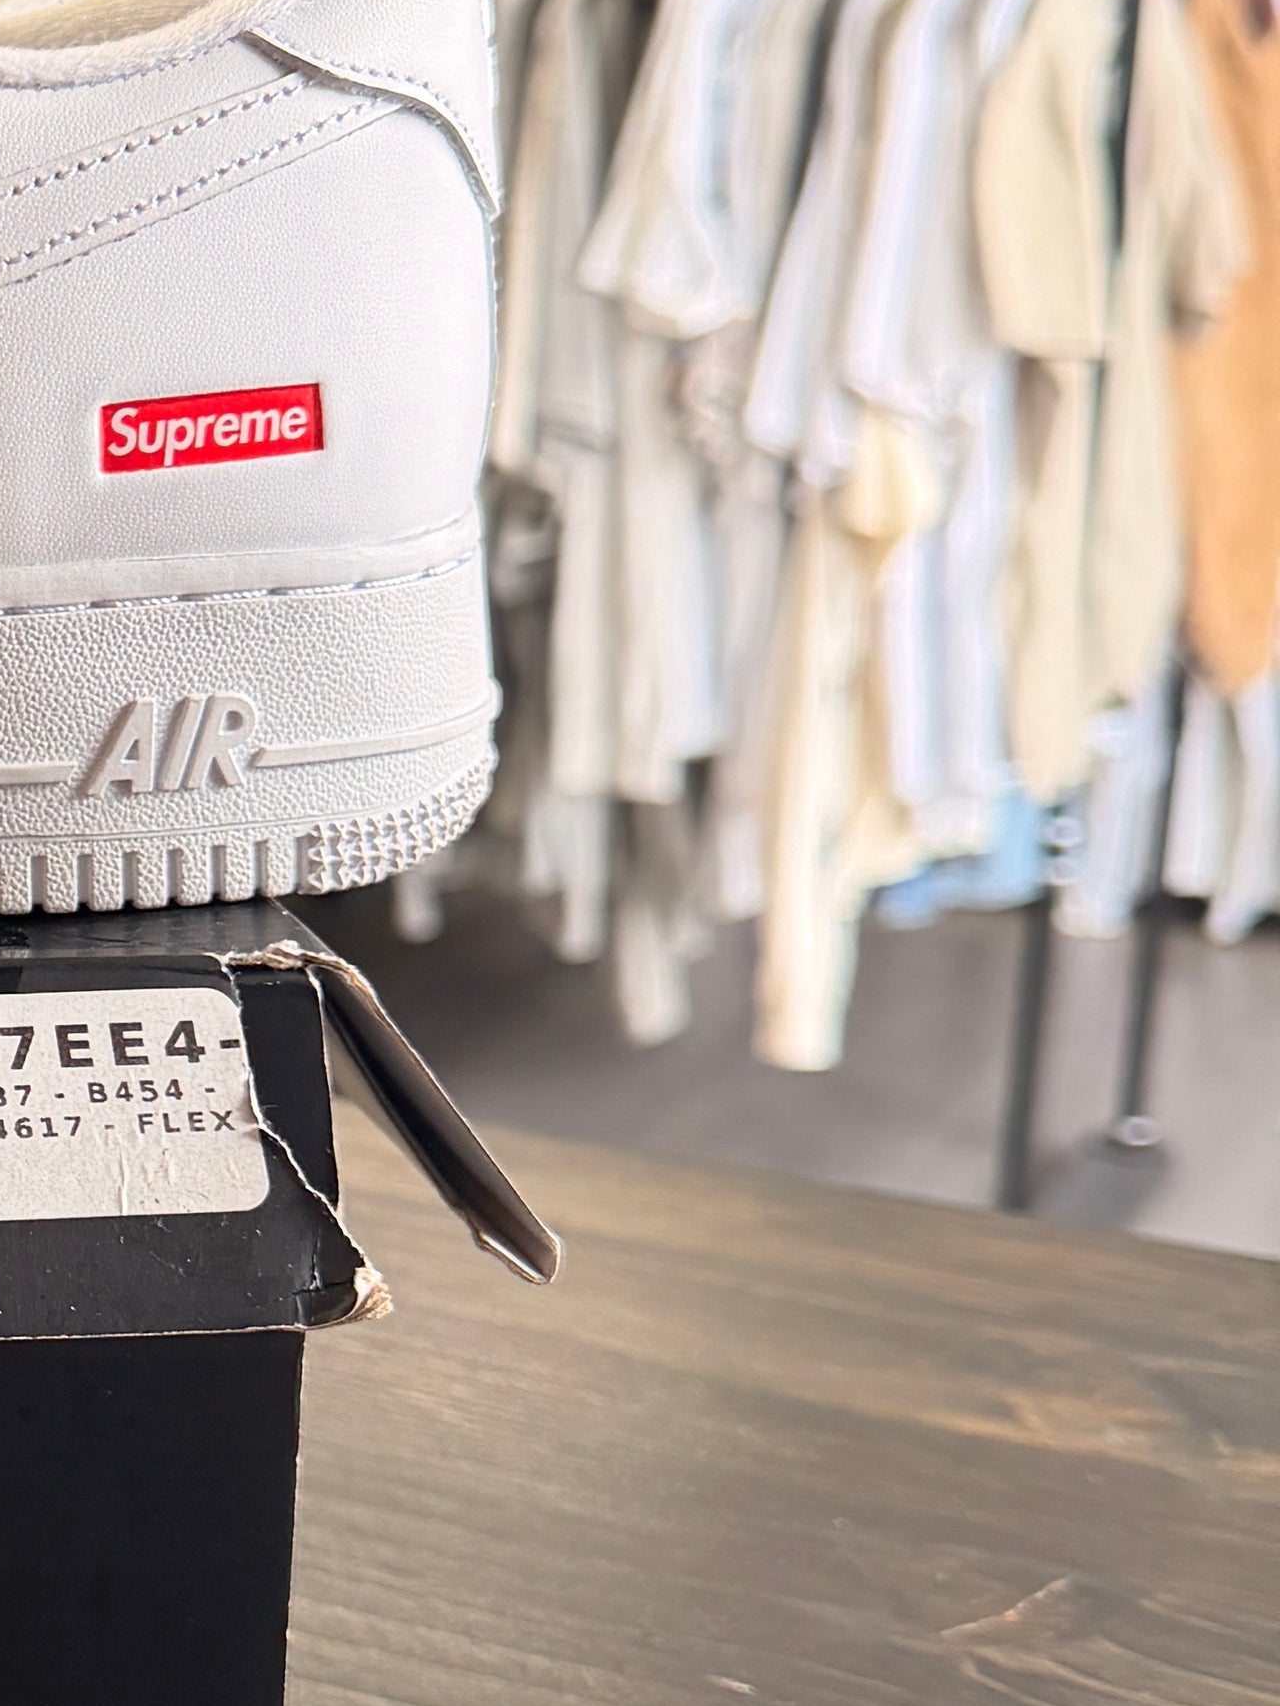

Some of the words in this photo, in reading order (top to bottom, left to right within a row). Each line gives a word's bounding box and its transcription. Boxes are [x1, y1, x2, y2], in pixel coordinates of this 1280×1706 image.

[107, 405, 308, 467] Supreme
[85, 693, 257, 796] AIR
[87, 1078, 184, 1104] B454
[137, 1109, 237, 1135] FLEX
